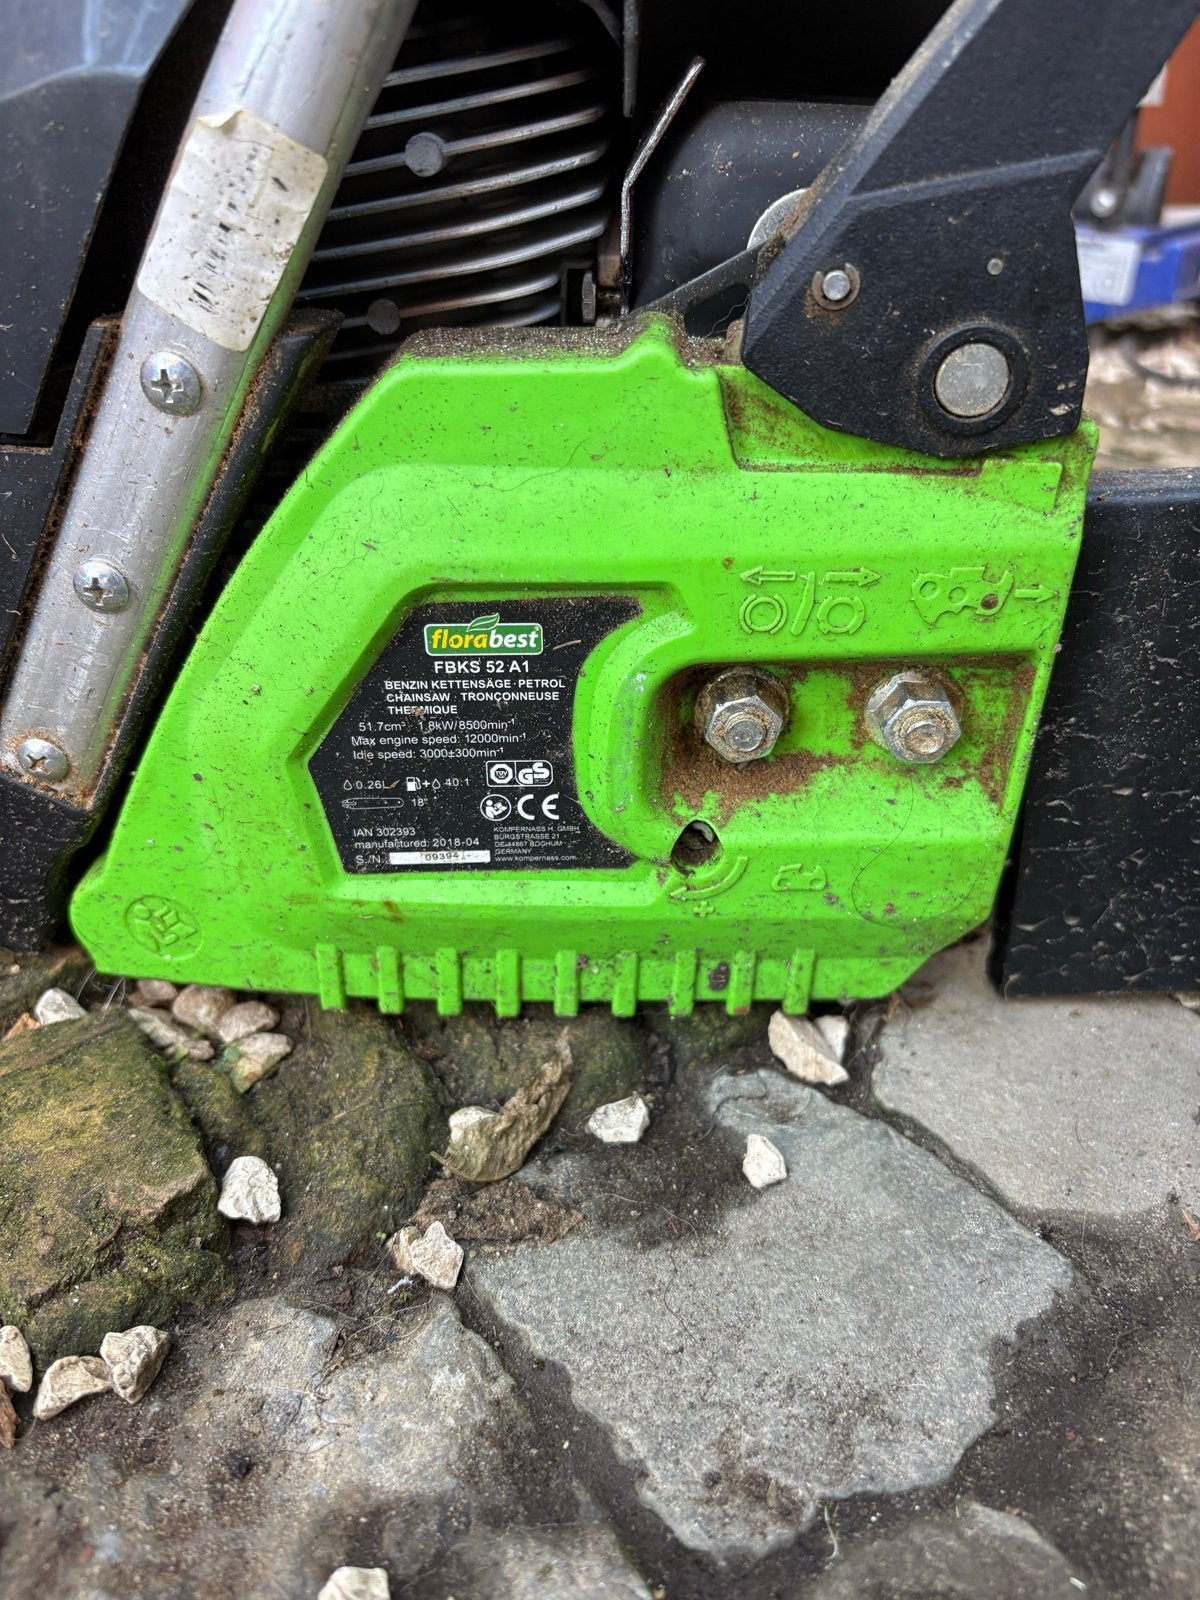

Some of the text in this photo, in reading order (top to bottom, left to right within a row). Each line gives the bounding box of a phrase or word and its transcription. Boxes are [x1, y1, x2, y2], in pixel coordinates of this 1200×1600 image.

[432, 629, 539, 649] florabest
[434, 660, 529, 674] FBKS 52 A1
[385, 678, 566, 690] BENZIN KETTENSÄGE PETROL
[386, 693, 450, 702] CHAINSAW
[380, 735, 418, 747] engine
[422, 734, 460, 746] speed:
[377, 749, 416, 761] speed:
[518, 762, 550, 785] GS
[517, 794, 560, 820] CE
[353, 827, 417, 838] IAN 302393
[355, 837, 480, 849] manufactured: 2018-04
